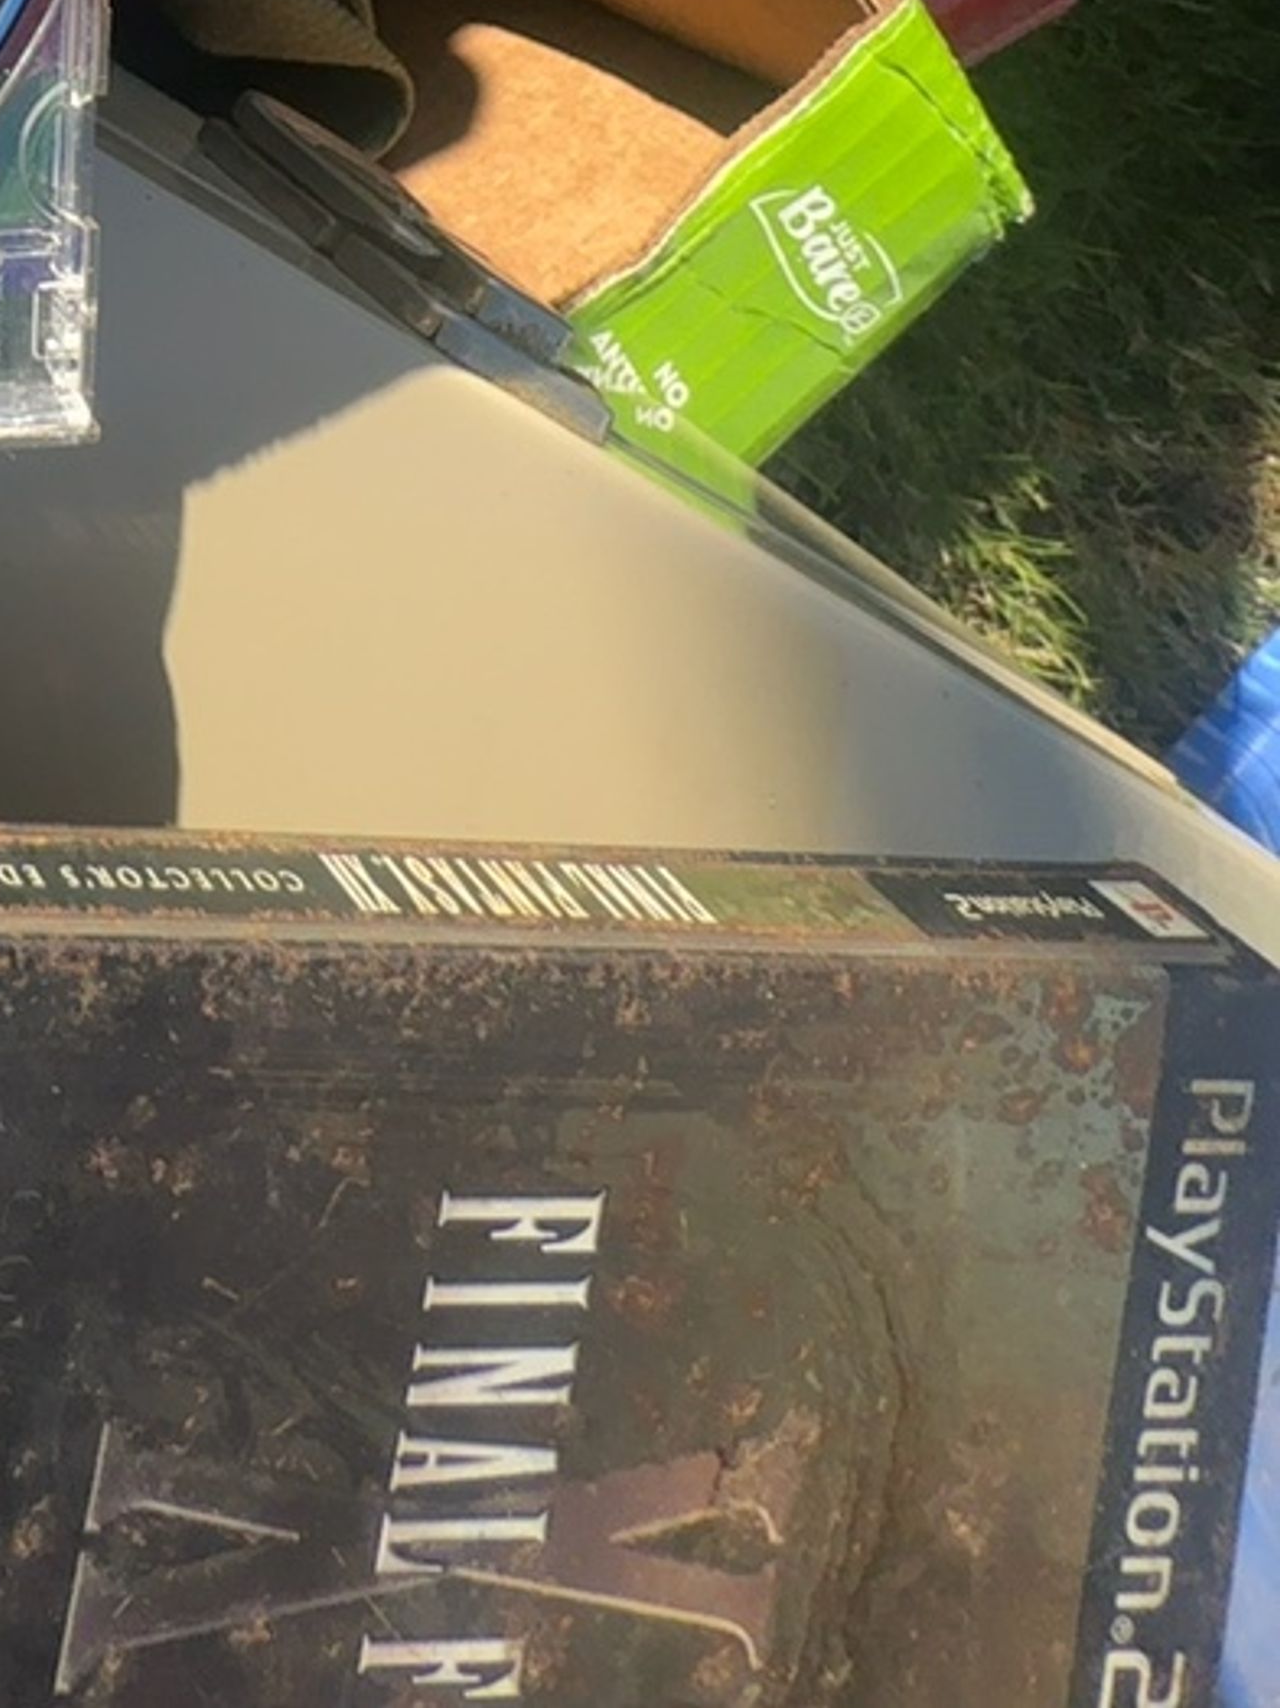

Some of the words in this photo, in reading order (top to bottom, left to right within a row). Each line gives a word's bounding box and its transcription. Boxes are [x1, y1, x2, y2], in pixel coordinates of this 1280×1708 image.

[778, 186, 863, 312] Bare
[830, 220, 871, 271] JUST
[653, 361, 690, 409] NO
[58, 865, 305, 892] COLLECTOR'S
[320, 854, 401, 914] XII
[558, 863, 717, 924] FINAL
[1113, 1077, 1255, 1612] PlayStation
[374, 1189, 608, 1576] FINAL
